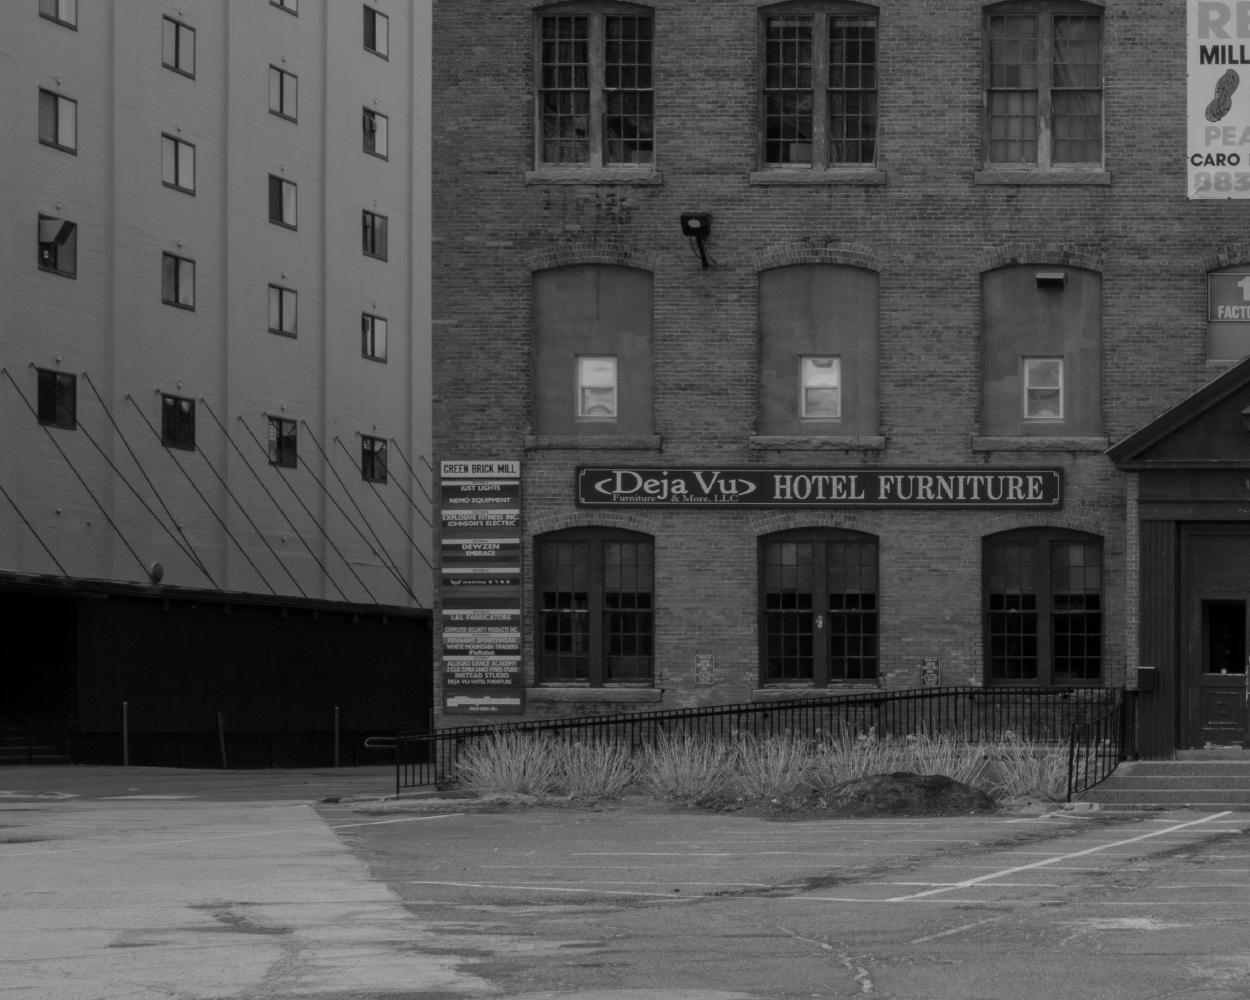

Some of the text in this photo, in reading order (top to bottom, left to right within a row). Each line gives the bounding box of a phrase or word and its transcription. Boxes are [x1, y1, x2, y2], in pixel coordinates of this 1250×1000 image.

[1200, 44, 1250, 65] MILL
[1190, 152, 1241, 167] CARO
[472, 464, 494, 474] BRICK
[498, 464, 517, 474] MILL
[612, 470, 739, 500] Deja Vu
[773, 475, 1043, 500] HOTEL FURNITURE
[613, 494, 656, 502] Furniture
[714, 494, 739, 502] LLC
